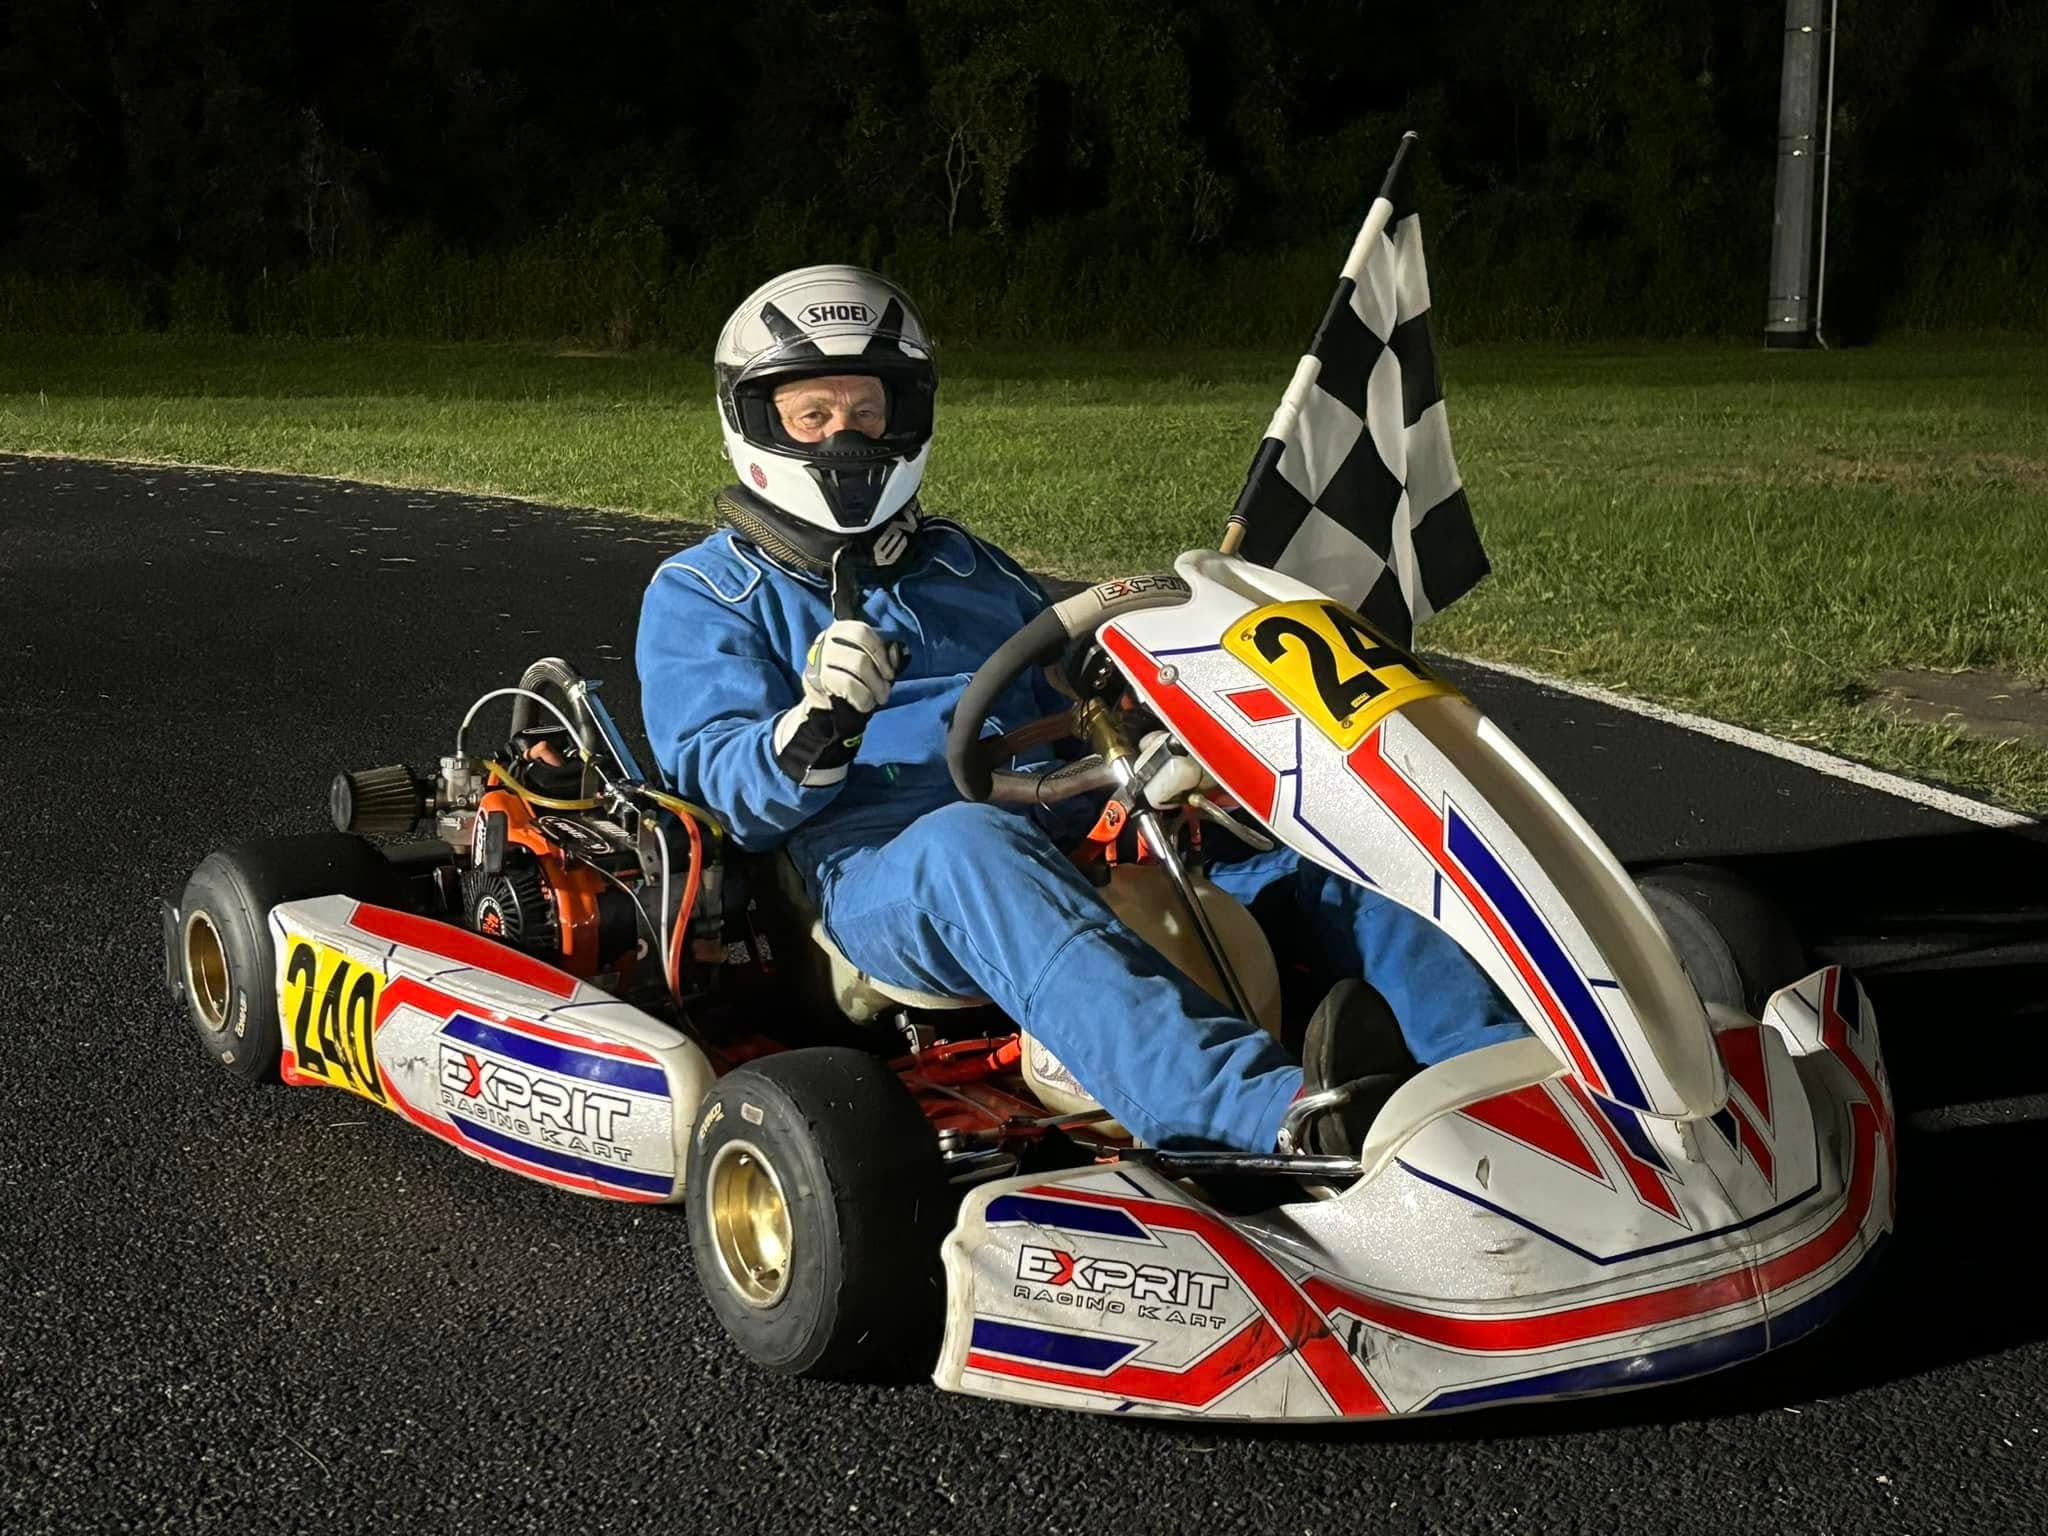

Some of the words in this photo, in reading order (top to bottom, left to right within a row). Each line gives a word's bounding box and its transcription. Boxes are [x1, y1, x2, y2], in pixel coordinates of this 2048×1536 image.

[807, 305, 868, 323] SHOEI
[287, 943, 387, 1104] 240
[440, 1043, 631, 1142] EXPRIT
[441, 1090, 530, 1135] RACING
[541, 1128, 632, 1162] KART
[1014, 1285, 1125, 1314] RACING
[1138, 1305, 1226, 1329] KART
[1017, 1244, 1229, 1310] EXPRIT
